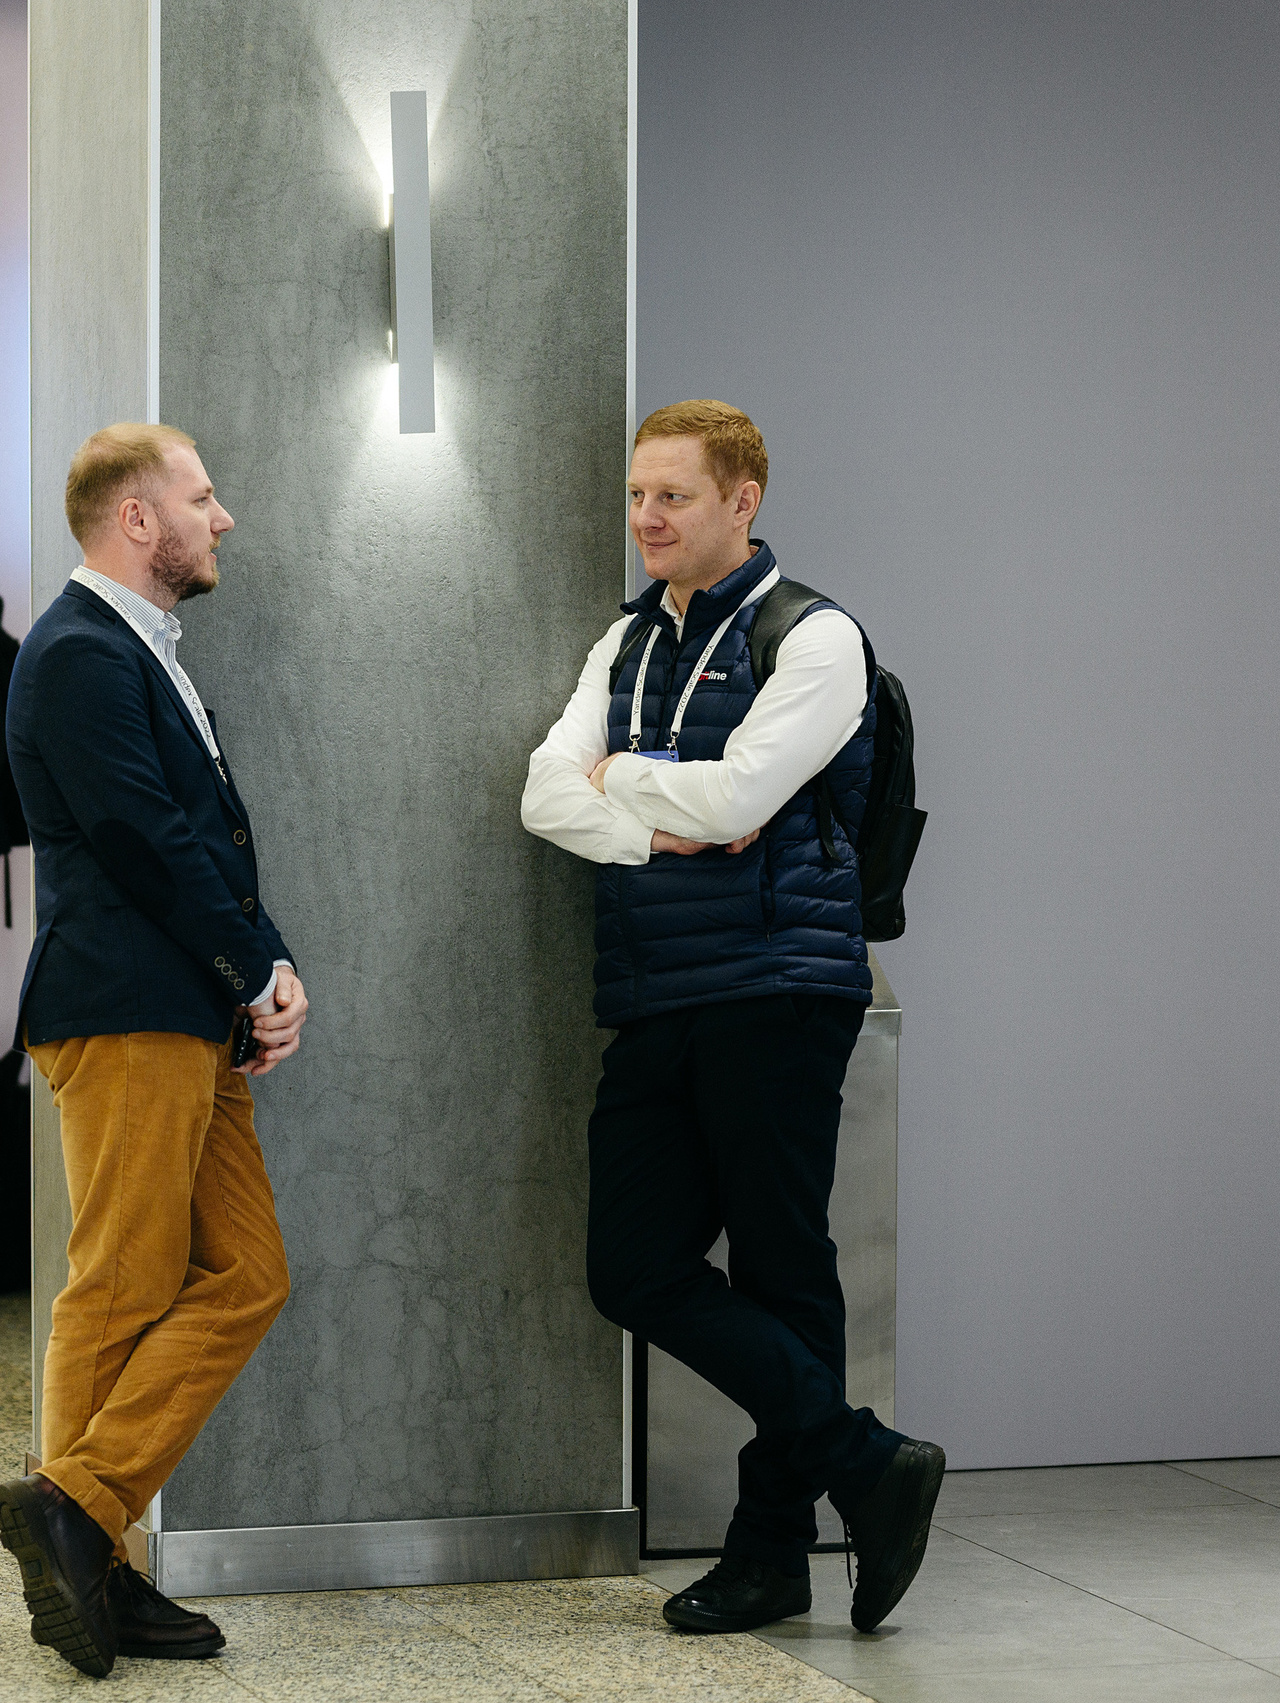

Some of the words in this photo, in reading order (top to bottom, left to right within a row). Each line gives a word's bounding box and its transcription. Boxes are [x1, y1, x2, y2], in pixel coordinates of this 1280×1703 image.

[77, 573, 94, 586] 2022
[92, 582, 111, 599] Scale
[110, 596, 132, 621] Yandex
[697, 644, 714, 670] Yandex
[687, 671, 701, 692] Scale
[178, 670, 193, 696] Yandex
[191, 696, 203, 718] Scale
[200, 718, 211, 738] 2022
[633, 688, 642, 716] Yandex
[678, 692, 689, 713] 2022
